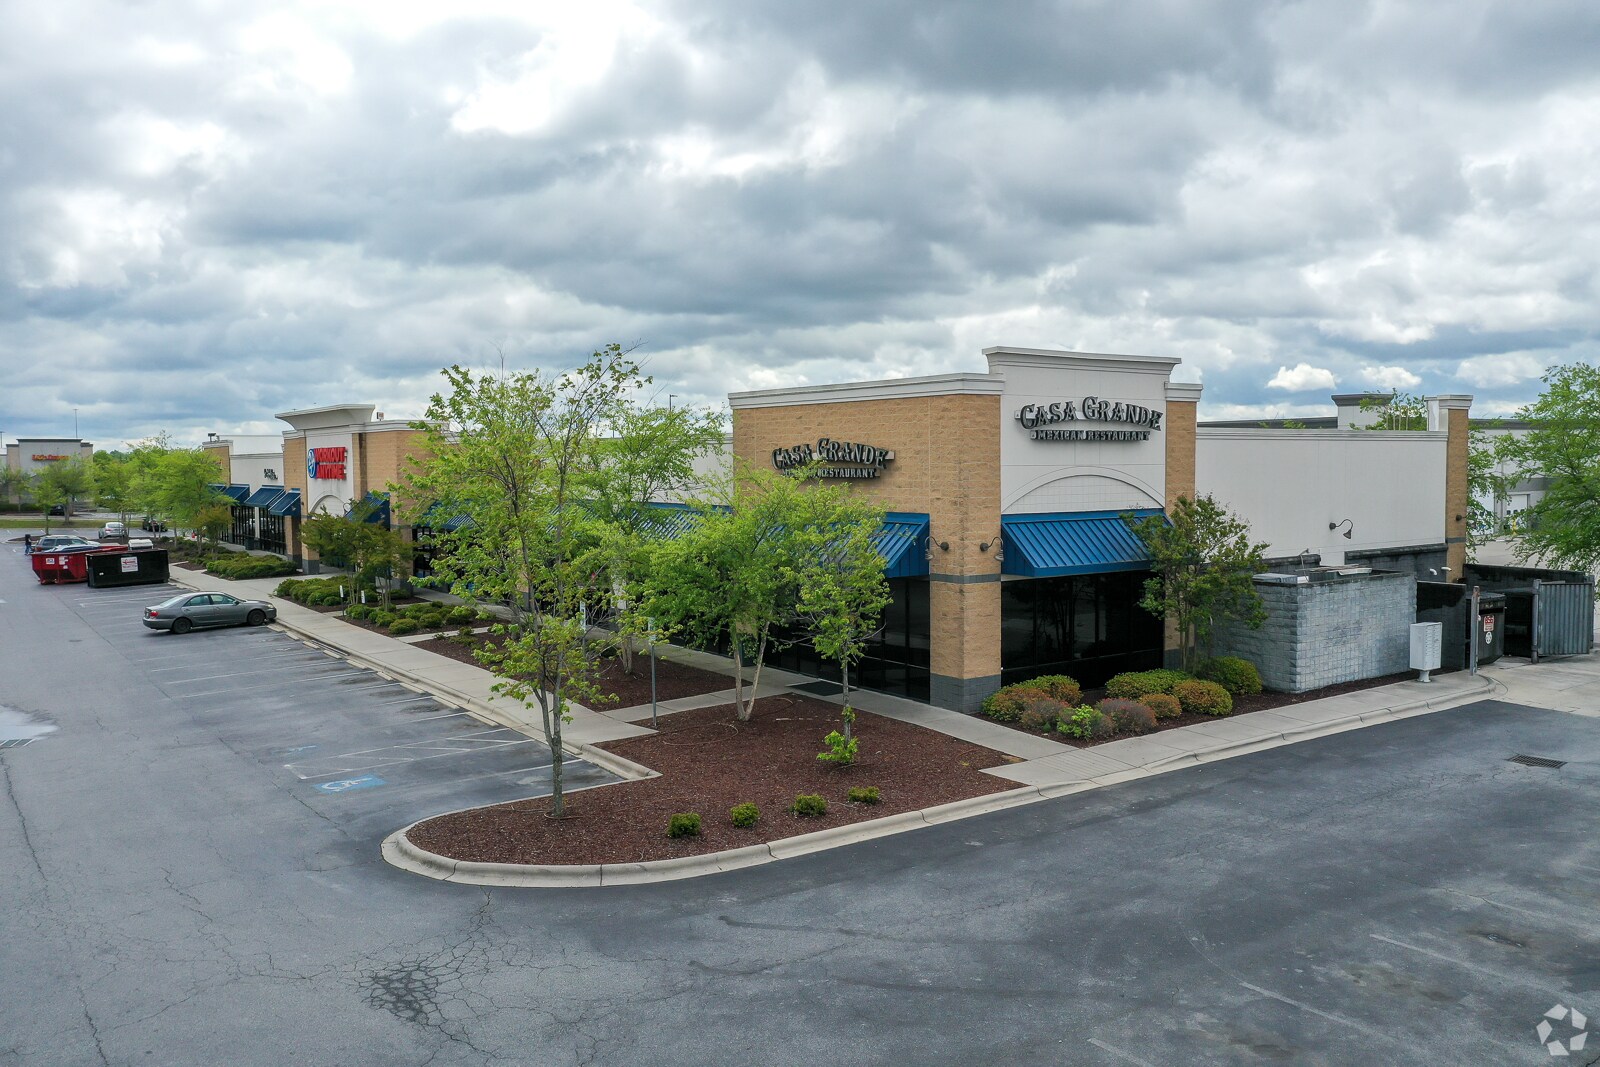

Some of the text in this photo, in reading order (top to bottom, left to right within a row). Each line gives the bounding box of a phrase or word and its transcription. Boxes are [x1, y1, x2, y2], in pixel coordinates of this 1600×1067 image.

[1020, 396, 1163, 431] CASA GRANDE
[1035, 430, 1151, 441] MEXICAN RESTAURANT
[772, 438, 889, 470] CASA GRANDE
